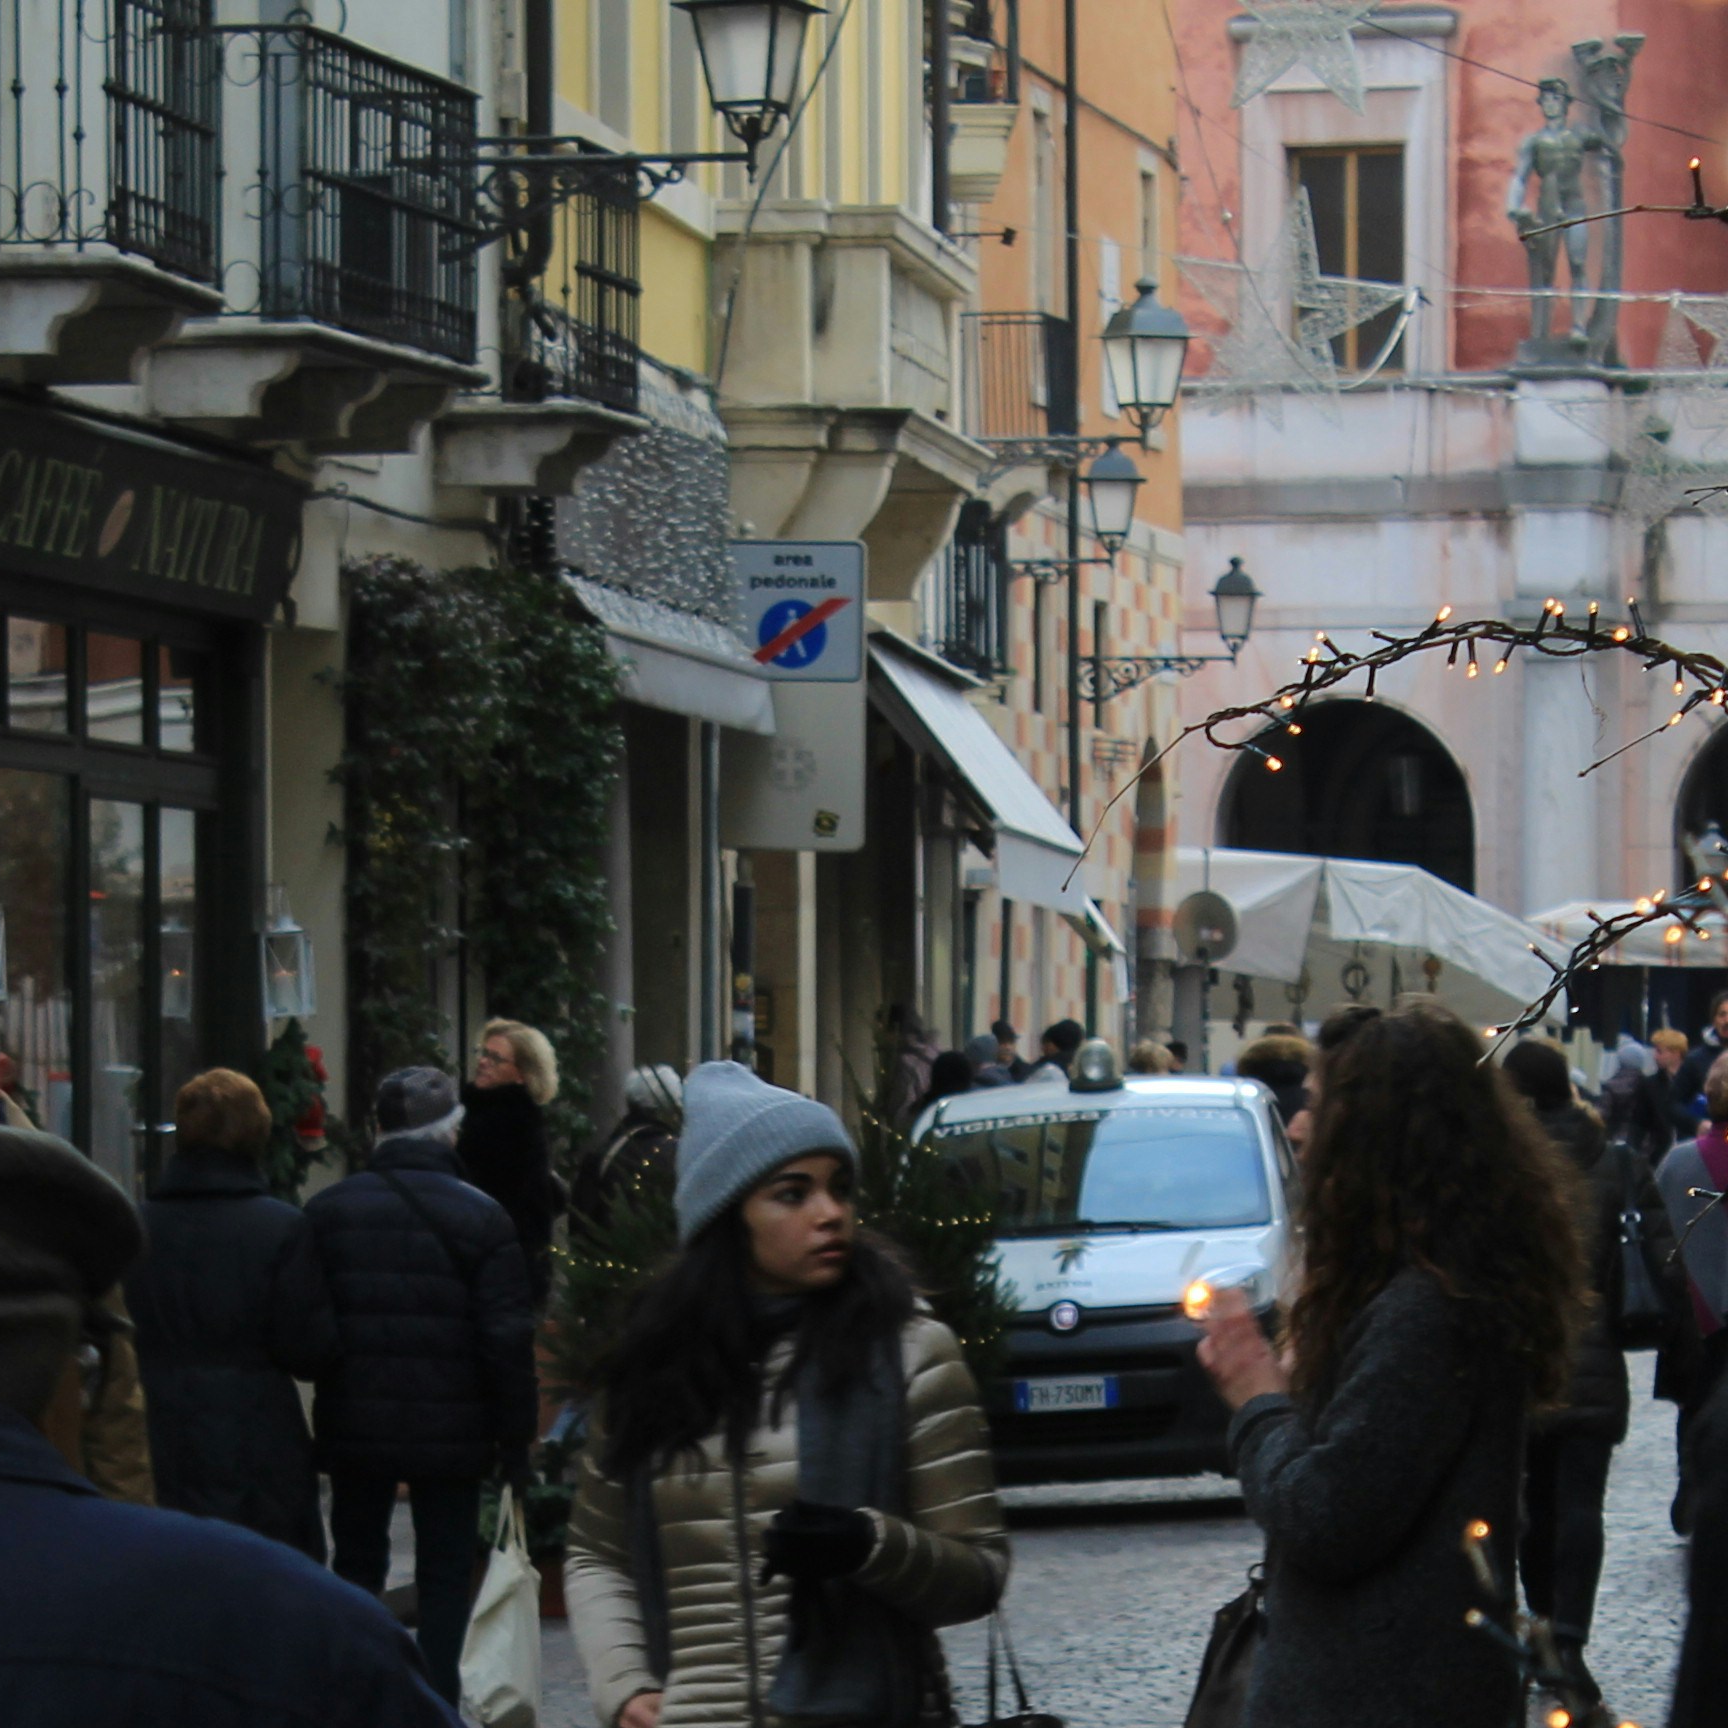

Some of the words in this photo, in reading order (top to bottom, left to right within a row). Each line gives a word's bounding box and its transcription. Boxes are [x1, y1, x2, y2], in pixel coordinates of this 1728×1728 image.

[129, 484, 268, 596] NATURA
[773, 555, 814, 567] area
[749, 574, 837, 591] pedonale
